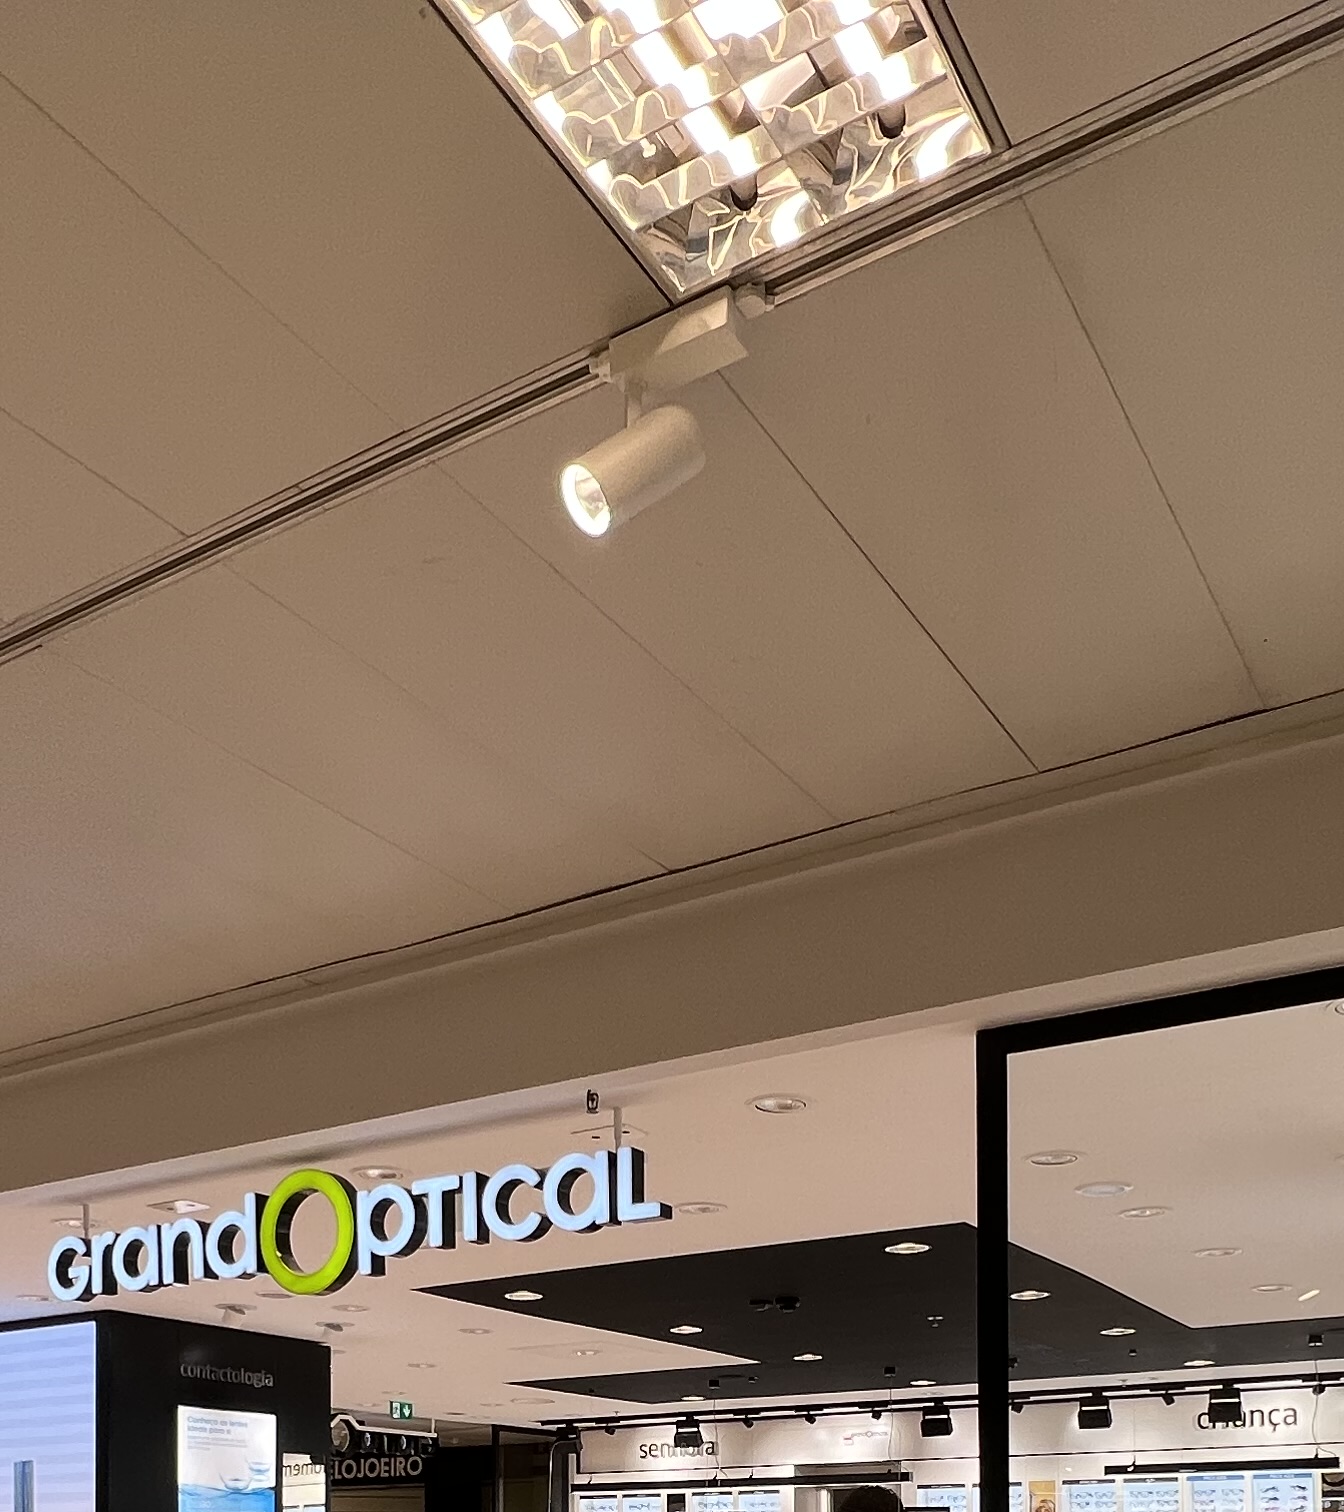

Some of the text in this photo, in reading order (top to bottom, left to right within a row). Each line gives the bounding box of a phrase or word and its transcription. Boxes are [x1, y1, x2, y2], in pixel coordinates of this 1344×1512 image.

[180, 1362, 274, 1388] contactologia
[1197, 1406, 1298, 1432] cança
[330, 1455, 423, 1480] LOJOEIRO
